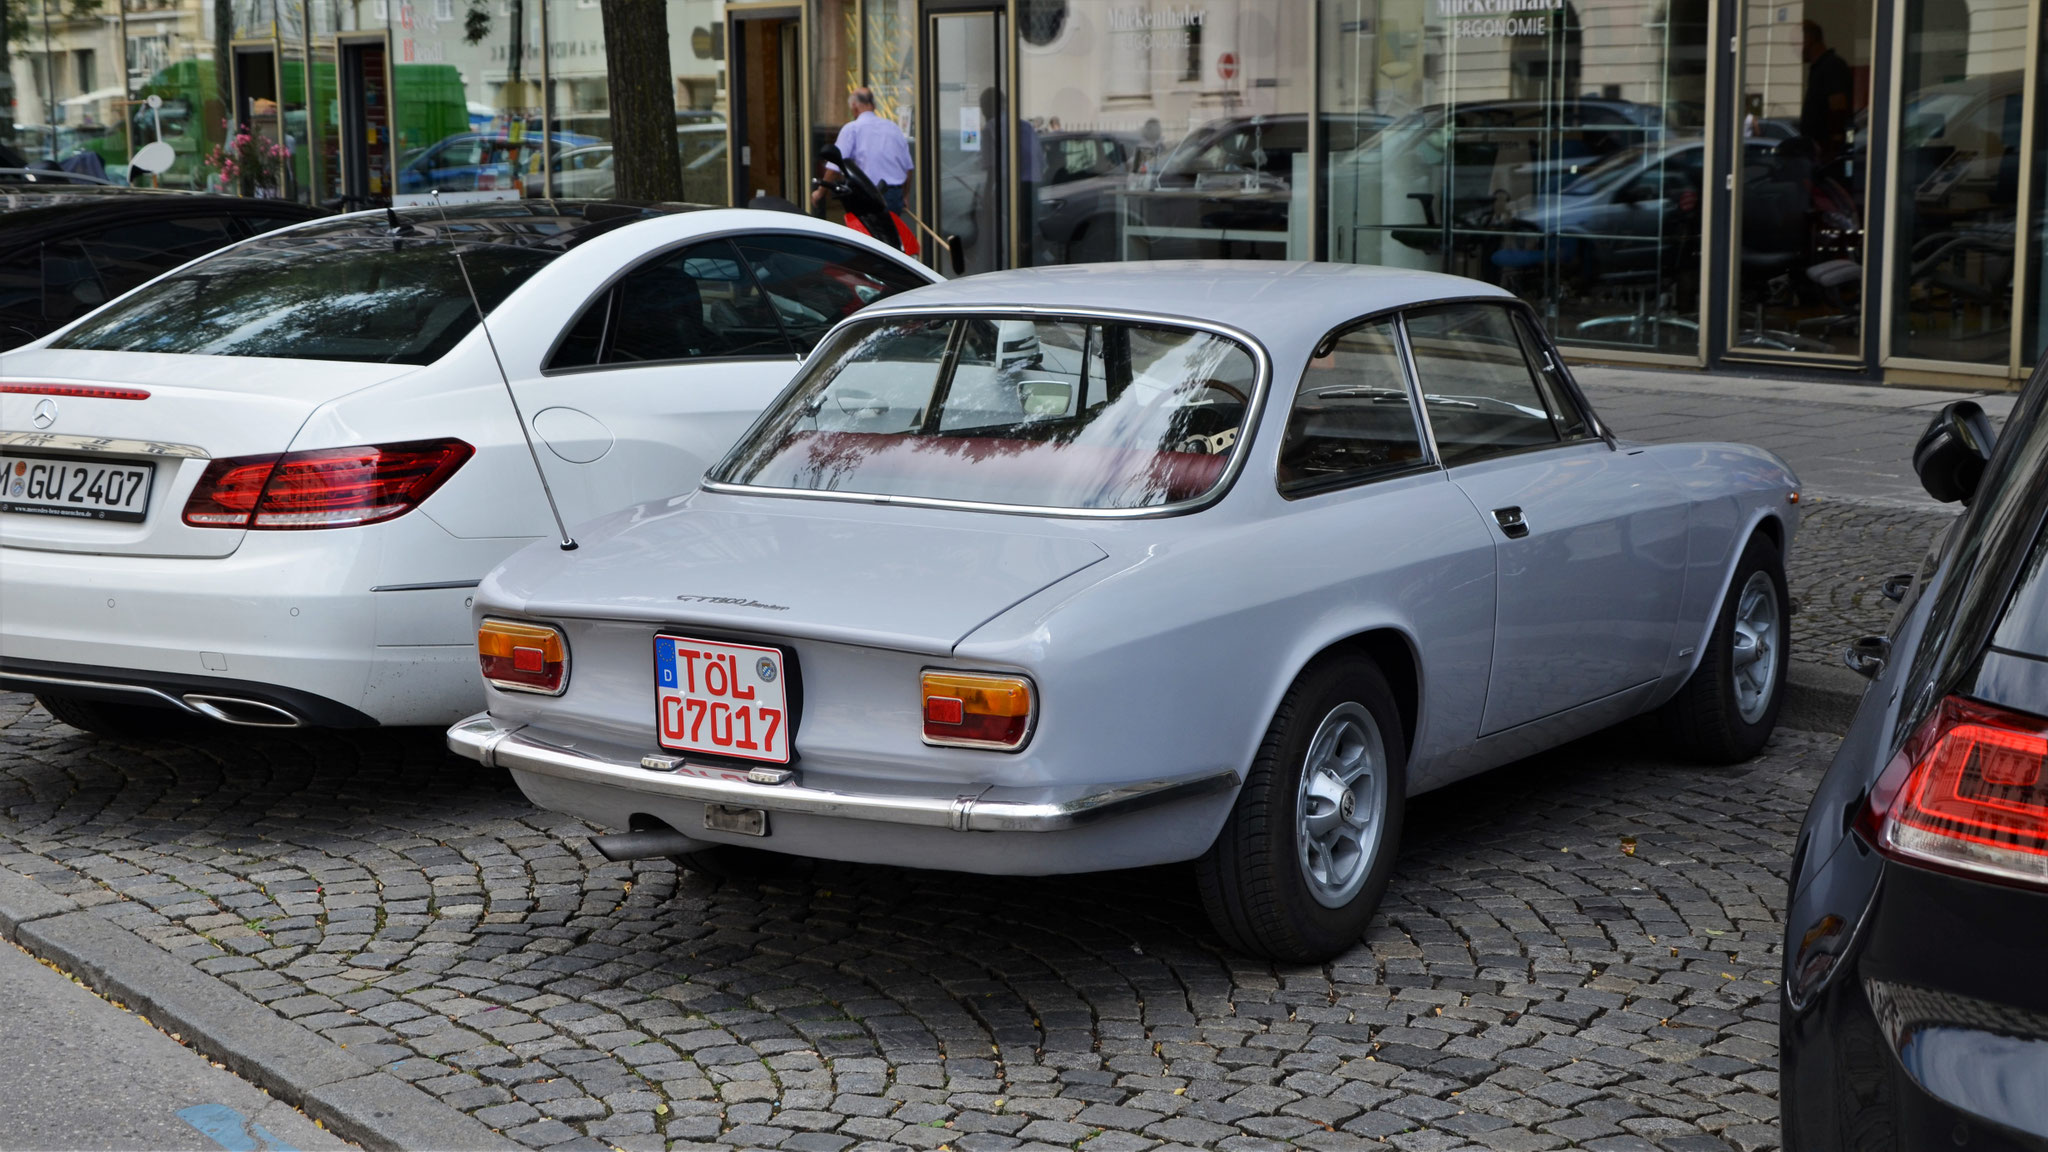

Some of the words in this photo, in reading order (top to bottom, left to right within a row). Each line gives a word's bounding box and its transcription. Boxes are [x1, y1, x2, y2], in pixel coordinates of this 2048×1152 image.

[1454, 16, 1546, 38] ERGONOMIE
[27, 464, 67, 500] GU
[68, 467, 144, 507] 2407
[15, 506, 92, 518] www.mercedes-benz-muenchen.de
[664, 668, 673, 682] D
[678, 648, 755, 701] TÖL
[662, 695, 781, 752] 07017
